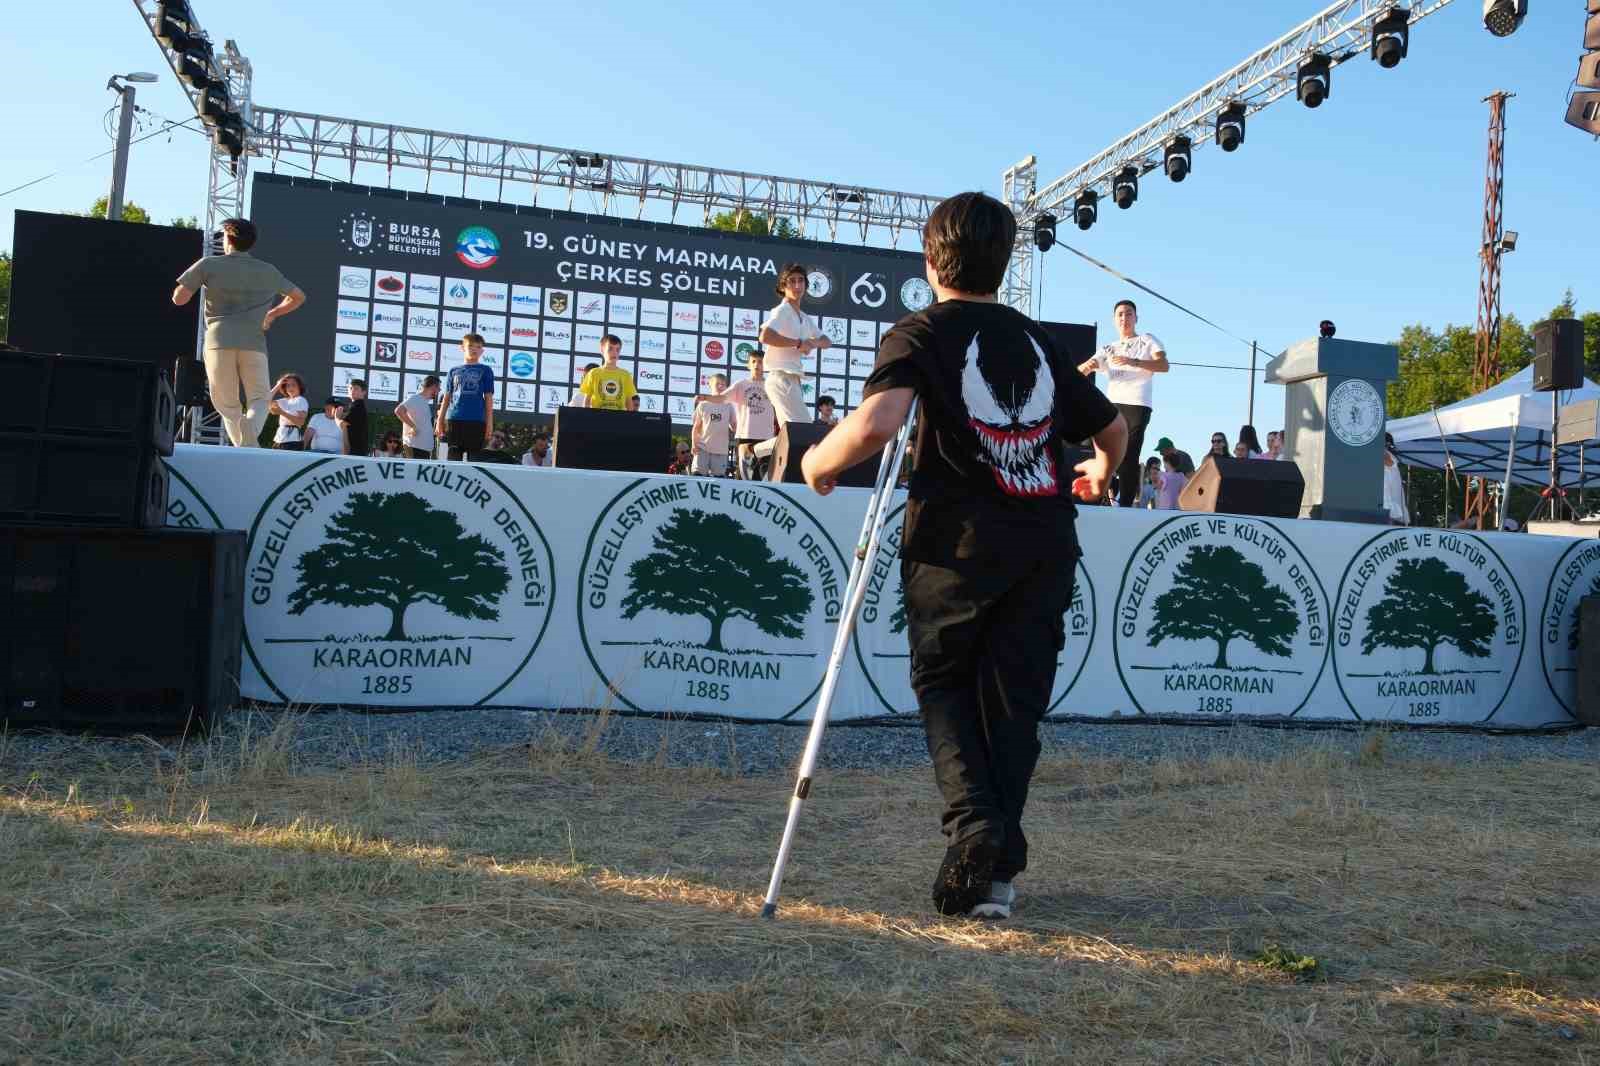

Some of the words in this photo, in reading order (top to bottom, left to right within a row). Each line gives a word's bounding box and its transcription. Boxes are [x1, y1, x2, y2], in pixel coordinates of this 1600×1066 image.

[388, 234, 441, 247] BÜYÜKŞEHİR
[389, 223, 441, 239] BURSA
[388, 244, 441, 256] BELEDİYESİ
[523, 230, 554, 250] 19.
[563, 234, 648, 261] GÜNEY
[655, 246, 778, 276] MARMARA
[556, 261, 652, 287] ÇERKES
[659, 271, 745, 297] ŞÖLENİ
[251, 465, 369, 606] GÜZELLEŞTİRME
[377, 462, 405, 480] VE
[416, 464, 492, 509] KÜLTÜR
[493, 507, 546, 607] DERNEĞİ
[588, 481, 690, 609] GÜZELLEŞTİRME
[696, 481, 721, 501] VE
[731, 488, 798, 535] KÜLTÜR
[1121, 522, 1202, 638] GÜZELLEŞTİRME
[1207, 519, 1227, 535] VE
[1234, 523, 1287, 565] KÜLTÜR
[1287, 564, 1324, 647] DERNEĞİ
[1337, 536, 1409, 647] GÜZELLEŞTİRME
[1413, 533, 1432, 548] VE
[1438, 534, 1487, 570] KÜLTÜR
[1486, 568, 1520, 646] DERNEĞİ
[313, 646, 473, 668] KARAORMAN
[643, 650, 781, 681] KARAORMAN
[361, 675, 413, 694] 1885
[685, 680, 730, 702] 1885
[1163, 674, 1275, 694] KARAORMAN
[1376, 679, 1476, 698] KARAORMAN
[1197, 696, 1233, 713] 1885
[1407, 701, 1441, 718] 1885
